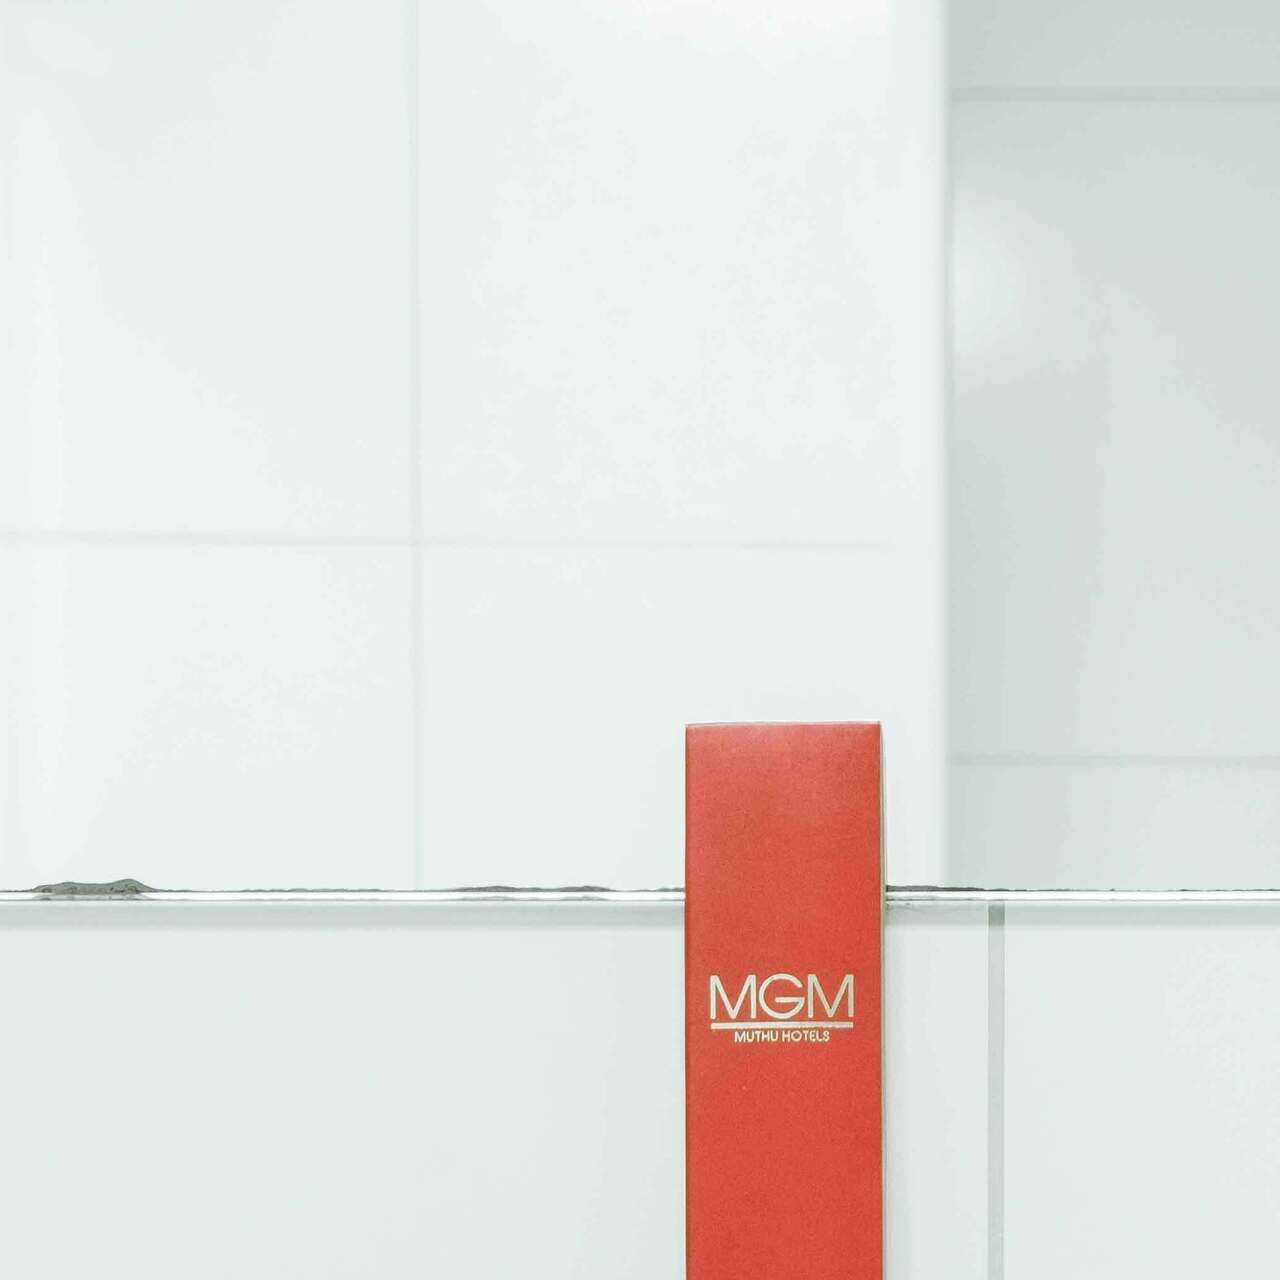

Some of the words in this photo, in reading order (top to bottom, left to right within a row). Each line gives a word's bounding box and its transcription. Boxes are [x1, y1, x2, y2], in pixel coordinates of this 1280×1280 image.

[709, 973, 855, 1020] MGM
[734, 1030, 778, 1043] MUTHU
[781, 1030, 830, 1043] HOTELS
